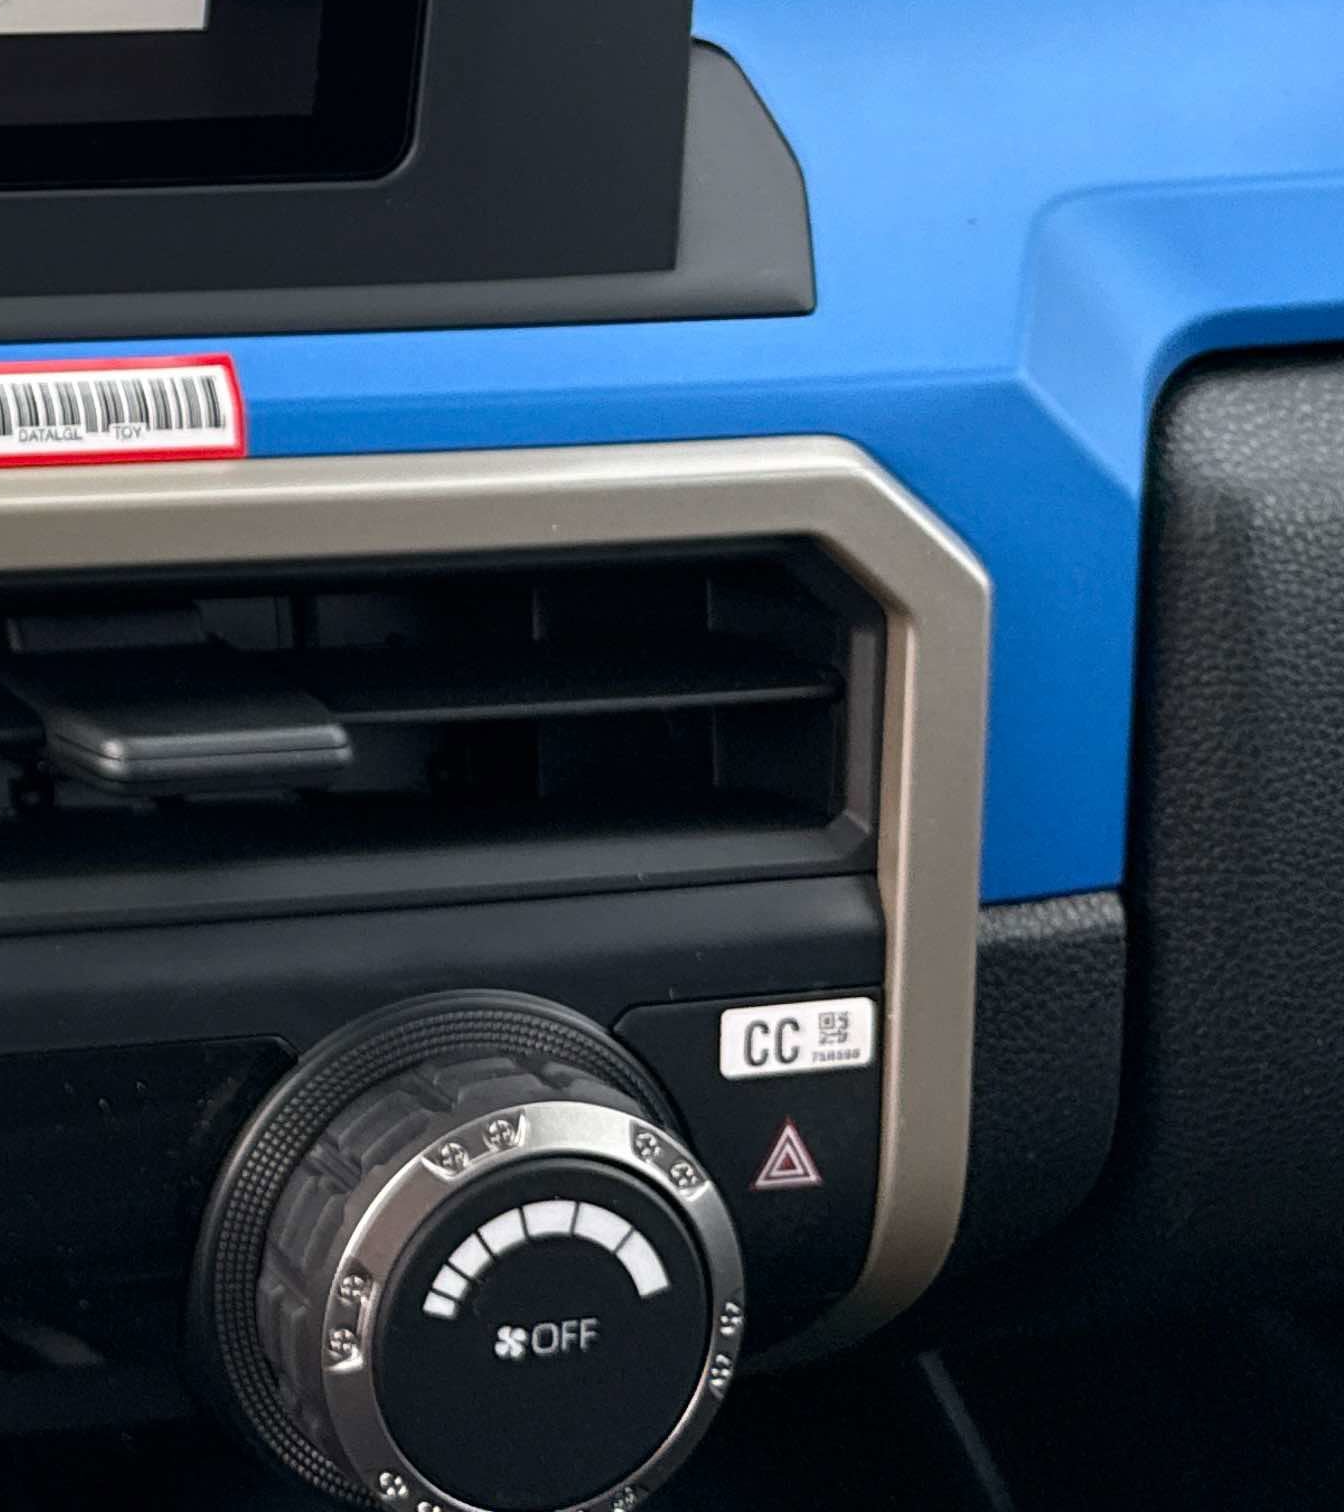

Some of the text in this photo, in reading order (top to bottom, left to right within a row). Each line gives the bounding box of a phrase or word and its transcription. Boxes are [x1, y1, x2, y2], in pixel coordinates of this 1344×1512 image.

[113, 425, 143, 440] TOY
[743, 1016, 801, 1068] CC
[530, 1318, 600, 1358] OFF
